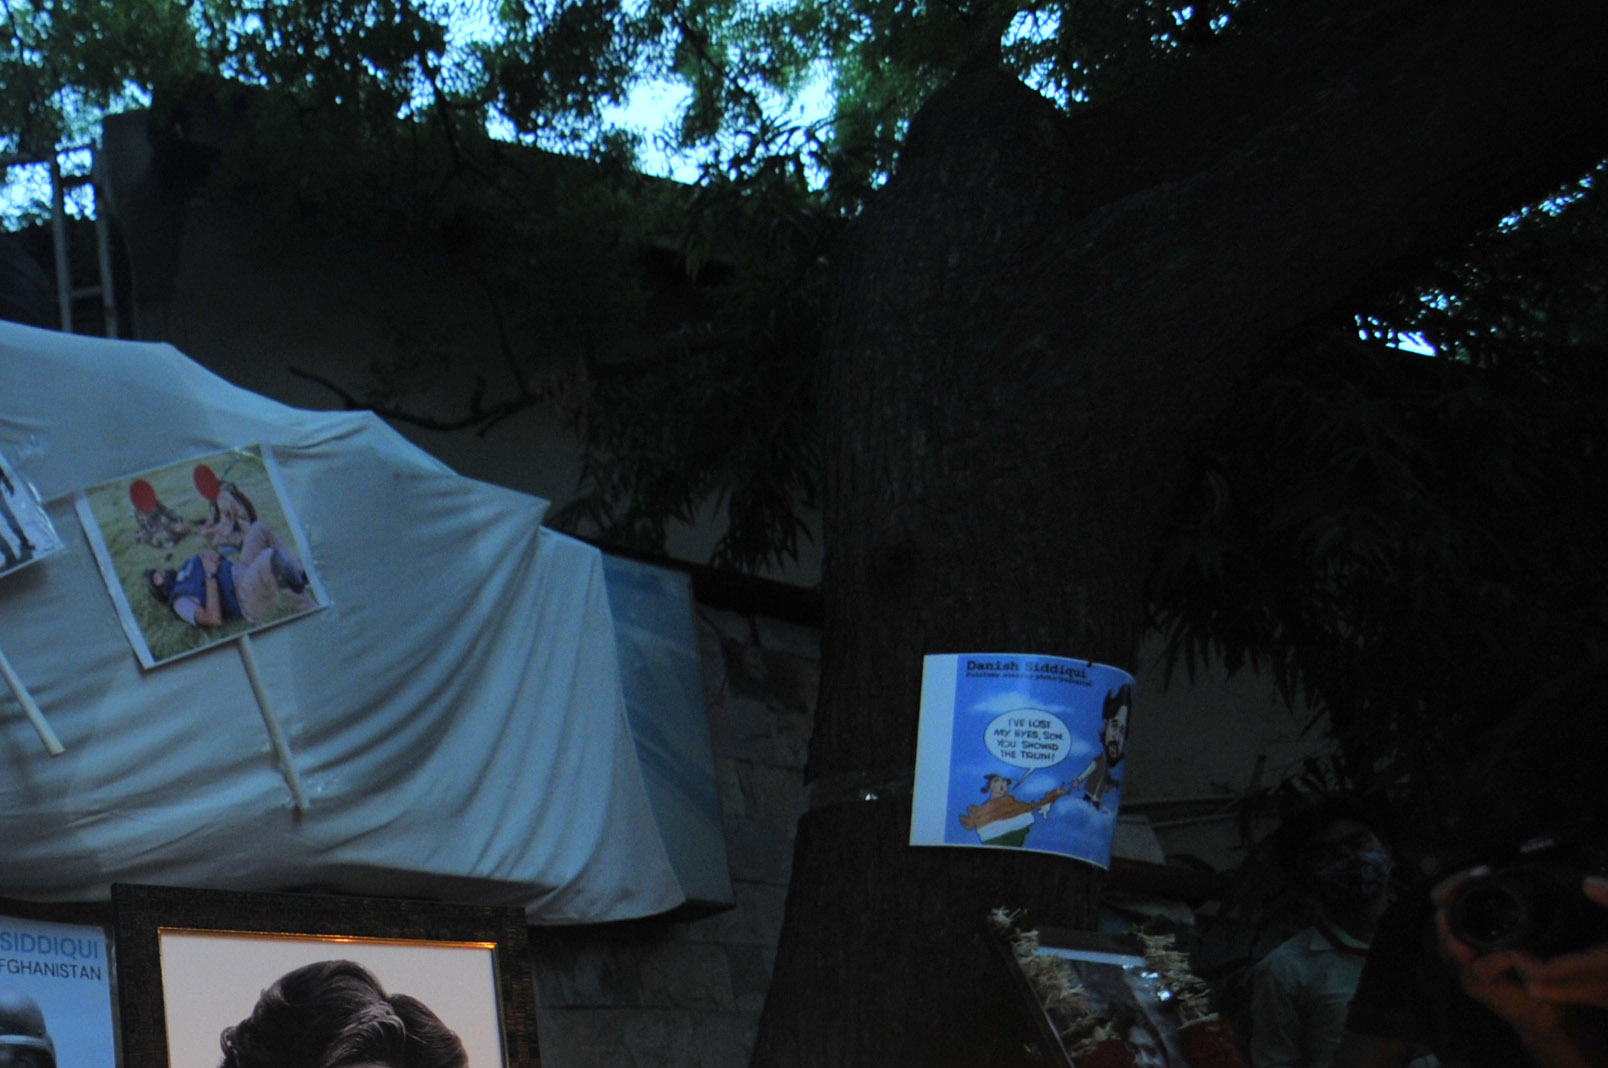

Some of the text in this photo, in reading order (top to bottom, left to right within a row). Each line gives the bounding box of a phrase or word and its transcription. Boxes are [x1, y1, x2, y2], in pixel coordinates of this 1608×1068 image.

[967, 660, 1088, 679] Danish Siddiqui
[1028, 719, 1051, 729] LOST
[993, 728, 1011, 737] MY
[997, 739, 1016, 748] YOU
[1000, 749, 1017, 759] THE
[0, 930, 99, 960] SIDDIQUI
